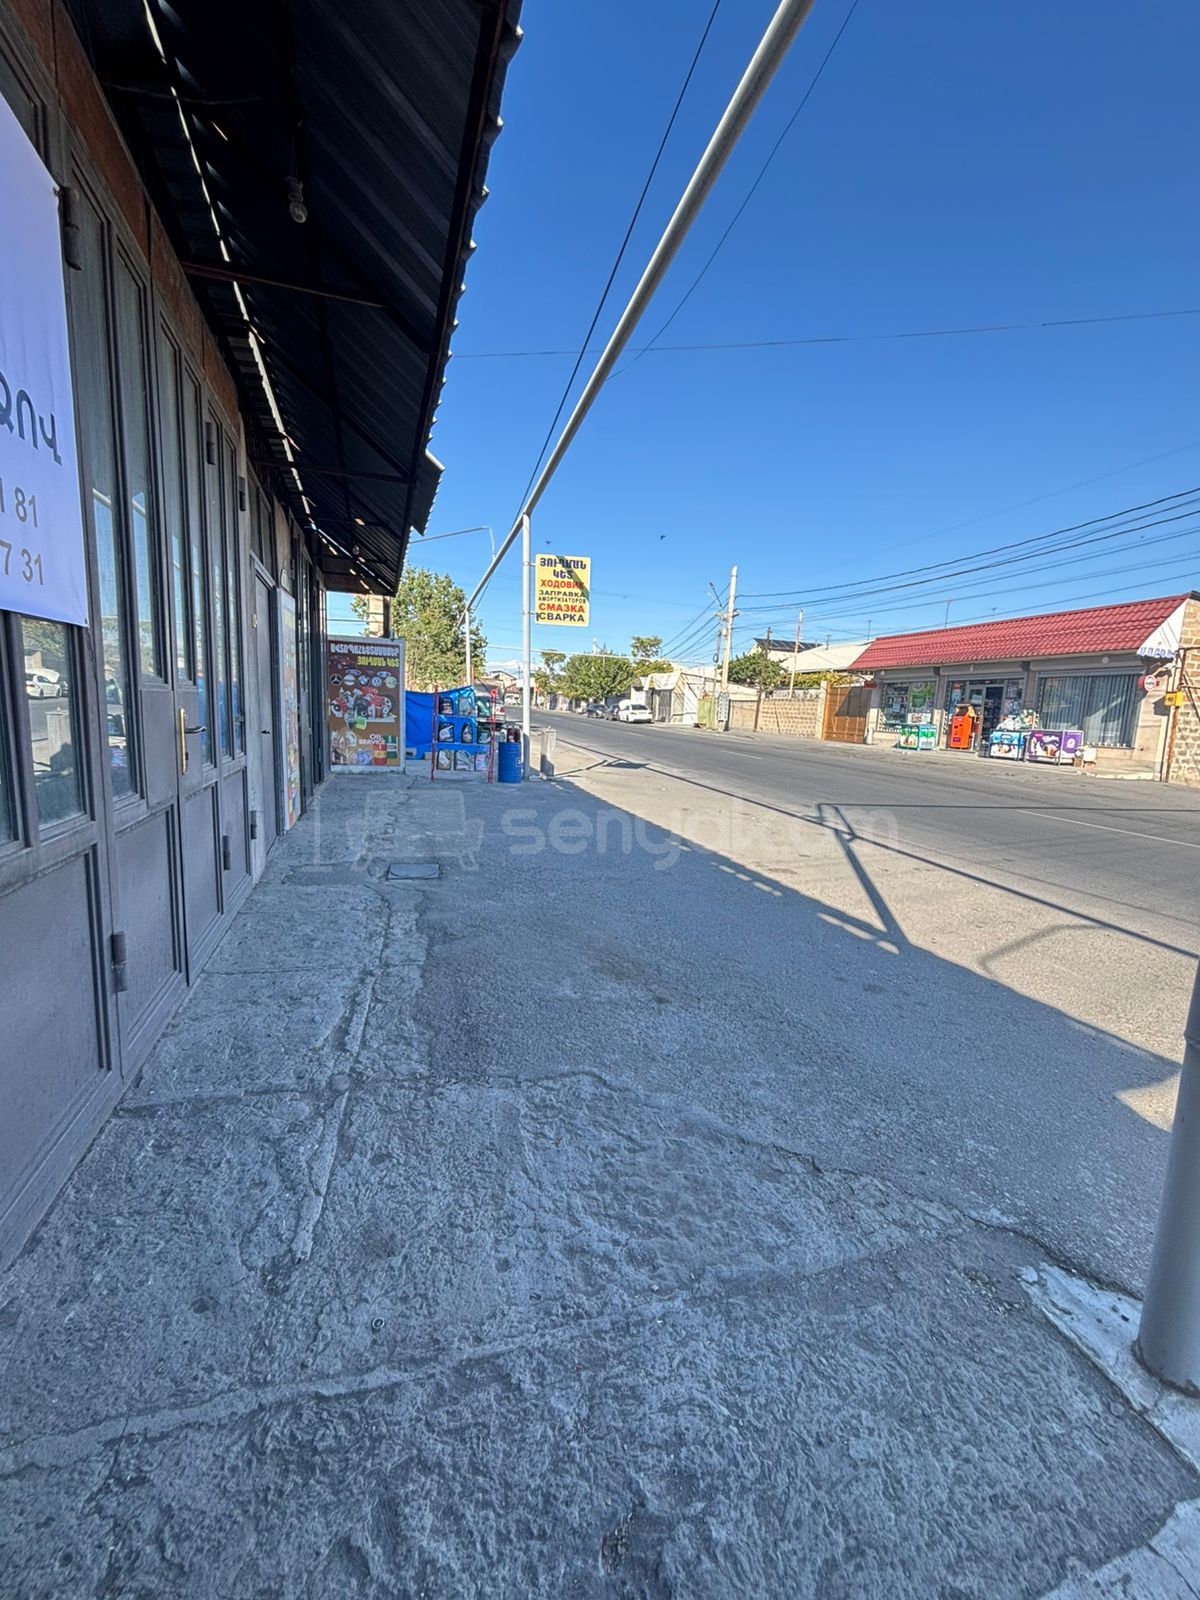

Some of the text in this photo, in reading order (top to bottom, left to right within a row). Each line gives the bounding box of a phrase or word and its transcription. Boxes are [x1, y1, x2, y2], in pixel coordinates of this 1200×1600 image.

[15, 487, 38, 528] 81
[21, 548, 44, 586] 31
[553, 569, 573, 579] ԿԵՏ
[539, 590, 585, 598] ЗАПРАВКА
[538, 596, 586, 604] АМОРТИЗАТОРОВ
[539, 603, 585, 613] СМАЗКА
[540, 612, 585, 622] СВАРКА
